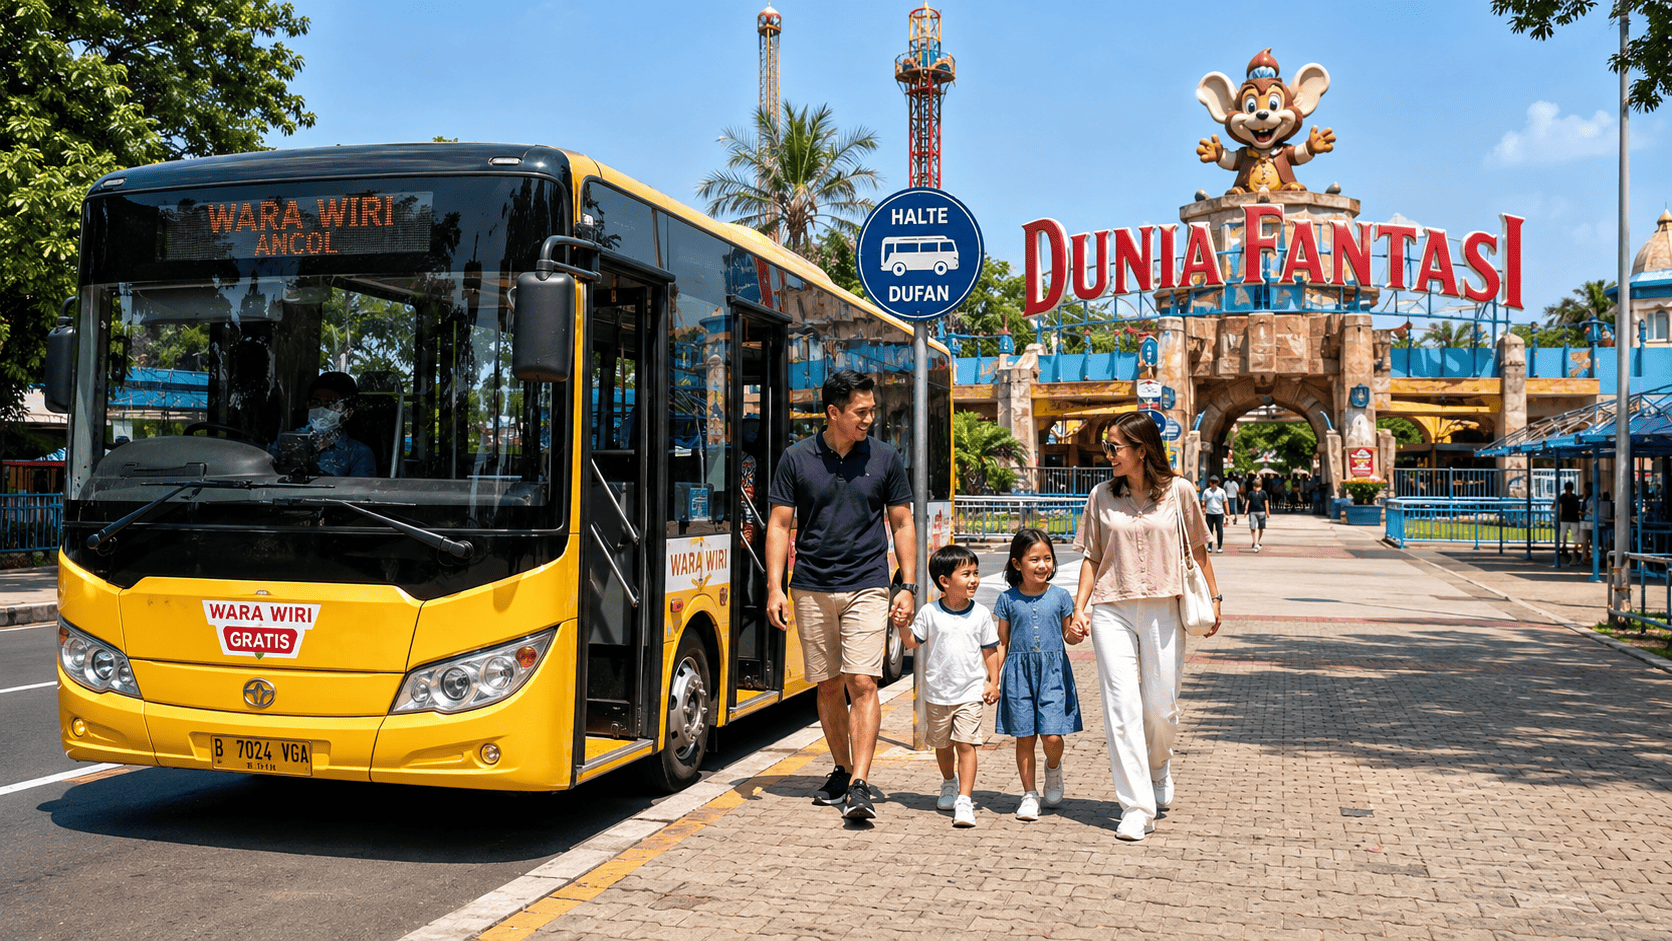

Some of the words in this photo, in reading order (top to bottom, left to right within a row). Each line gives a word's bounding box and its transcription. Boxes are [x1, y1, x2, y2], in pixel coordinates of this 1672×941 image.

[208, 201, 303, 234] WARA
[317, 196, 394, 228] WIRI
[891, 207, 948, 225] HALTE
[254, 231, 338, 256] ANCOL
[1022, 217, 1226, 319] DUNIA
[1240, 203, 1525, 311] FANTASI
[889, 285, 949, 302] DUFAN
[670, 551, 703, 577] WARA
[705, 548, 728, 572] WIRI
[209, 603, 264, 621] WARA
[270, 606, 312, 623] WIRI
[230, 631, 290, 649] GRATIS
[214, 738, 223, 757] B
[236, 740, 272, 760] 7024
[281, 742, 309, 763] VGA
